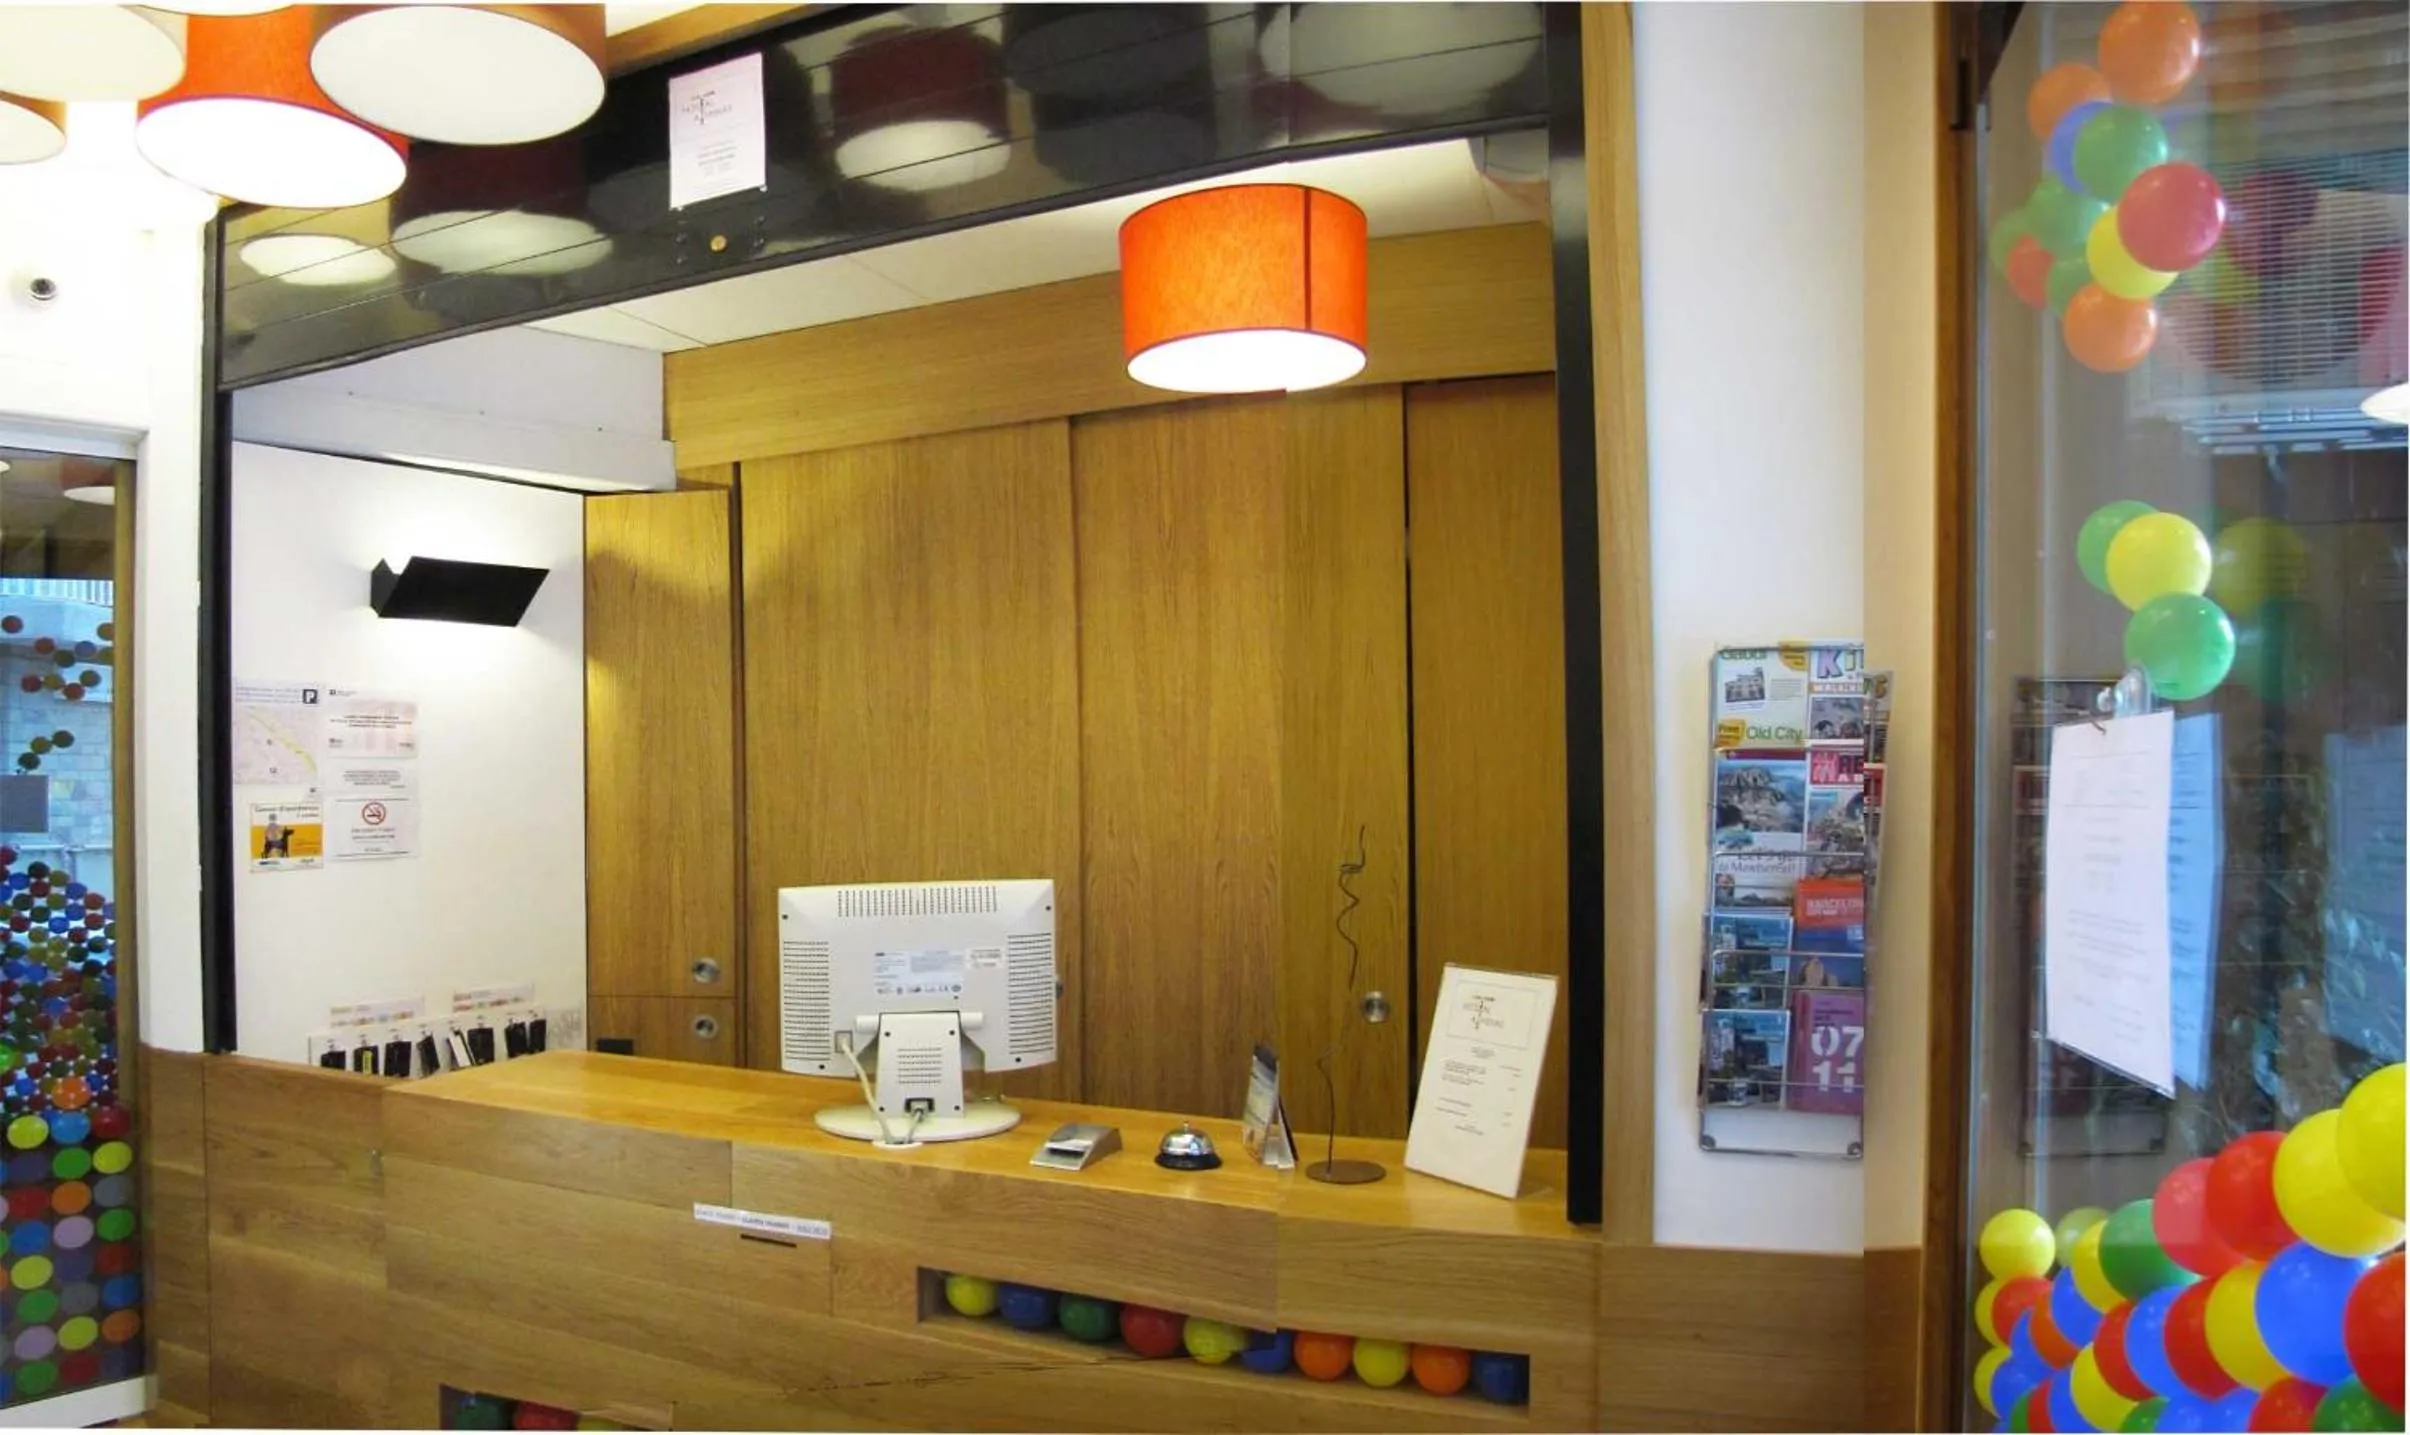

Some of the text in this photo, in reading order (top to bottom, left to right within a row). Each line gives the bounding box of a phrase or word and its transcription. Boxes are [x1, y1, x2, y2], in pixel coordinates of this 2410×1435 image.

[1746, 725, 1771, 740] Old
[1774, 725, 1803, 744] City
[1811, 1026, 1865, 1058] 07
[1811, 1060, 1857, 1094] 11
